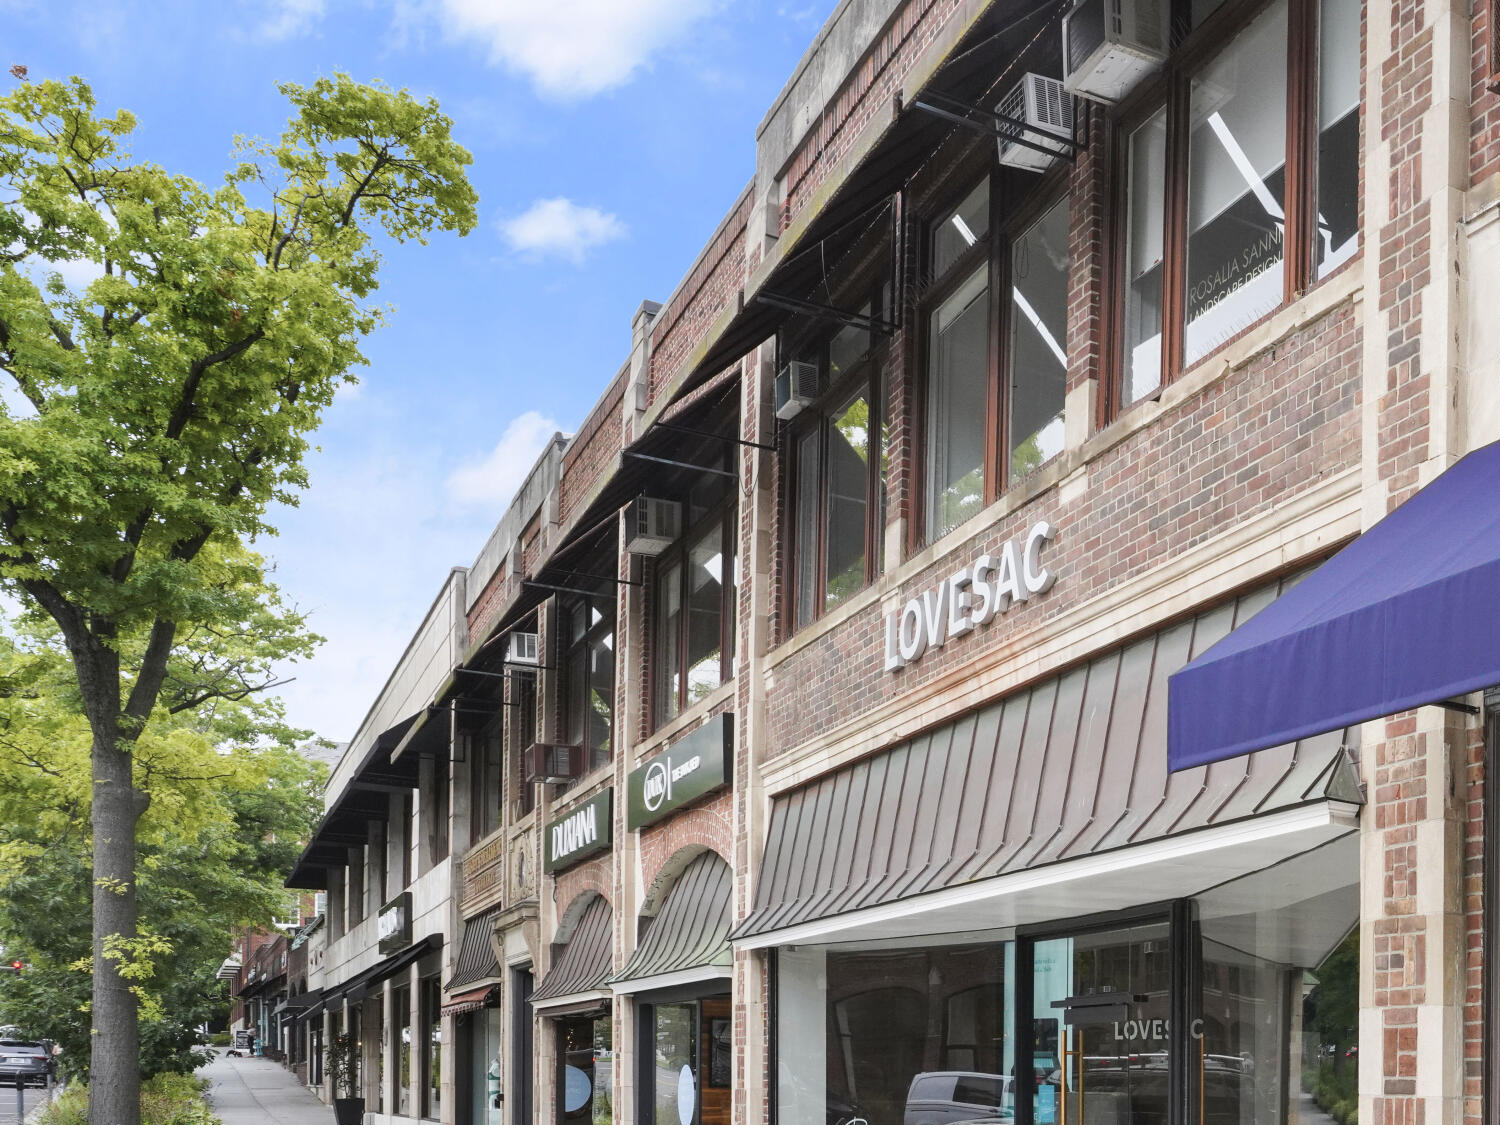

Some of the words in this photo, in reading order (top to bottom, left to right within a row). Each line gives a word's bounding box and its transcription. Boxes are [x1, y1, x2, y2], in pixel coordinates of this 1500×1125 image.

[1189, 277, 1244, 323] LANDSCAPE
[1245, 250, 1281, 285] DESIGN
[1190, 257, 1240, 307] ROSALIA
[1242, 225, 1281, 268] SANNI
[885, 520, 1058, 673] LOVESAC
[1114, 1018, 1204, 1040] LOVEC
